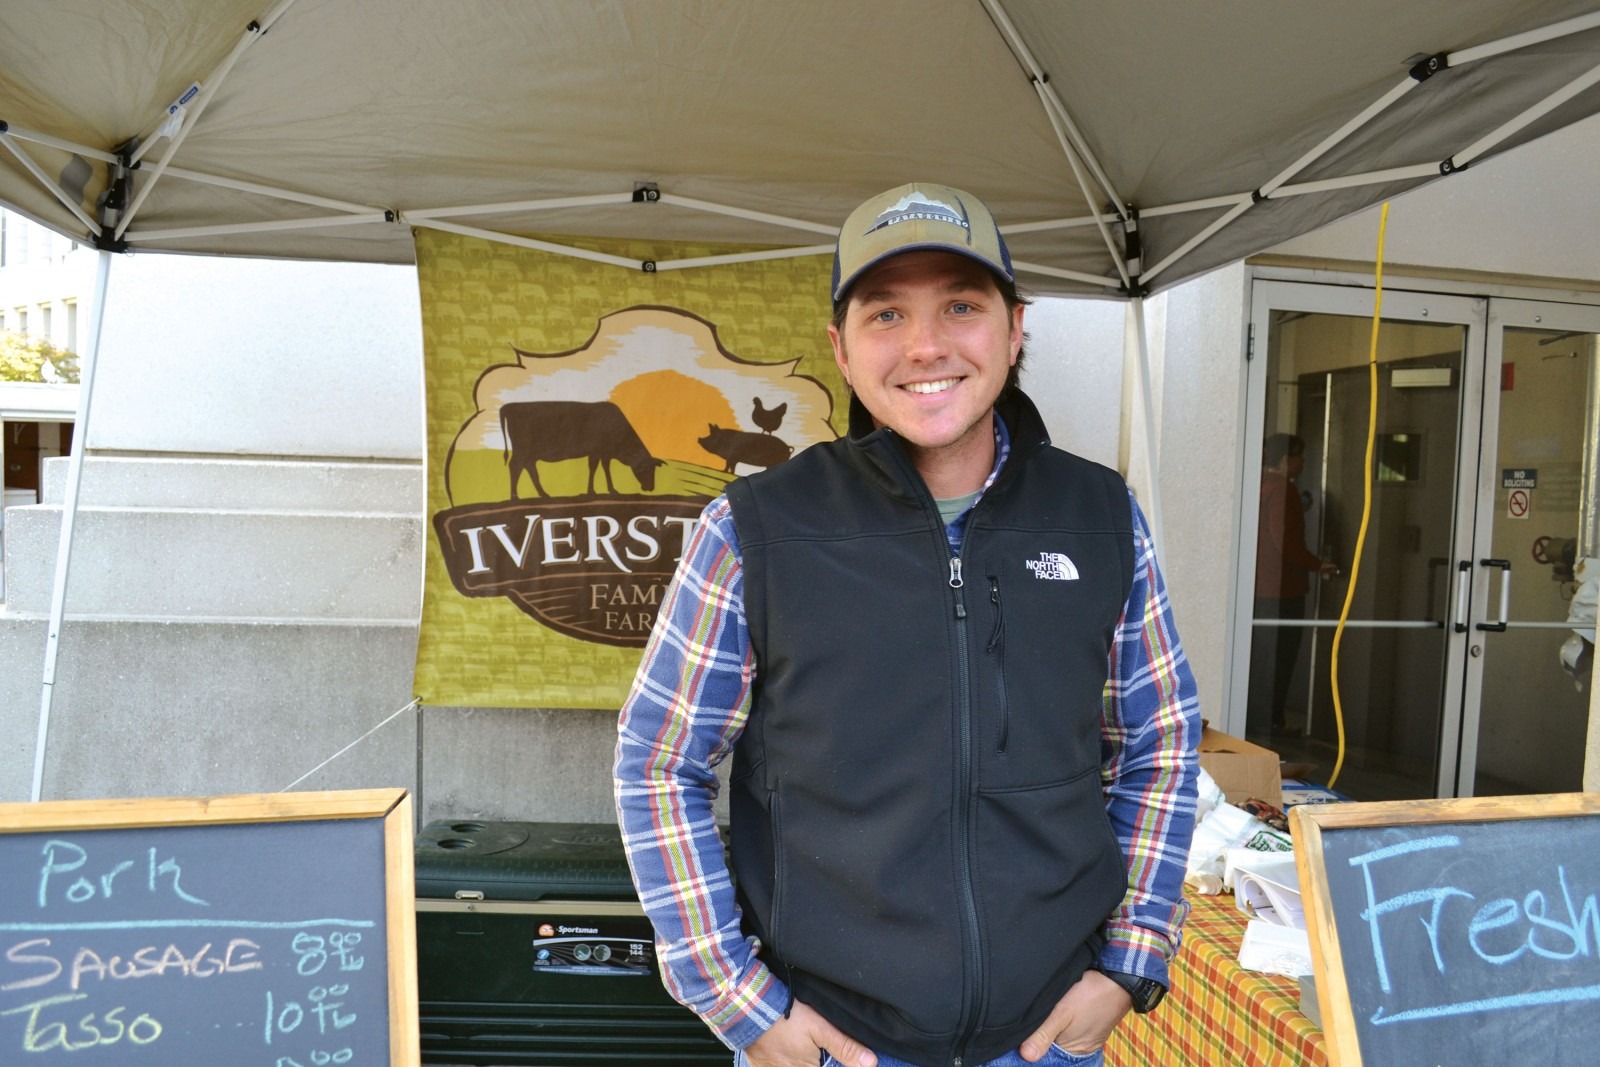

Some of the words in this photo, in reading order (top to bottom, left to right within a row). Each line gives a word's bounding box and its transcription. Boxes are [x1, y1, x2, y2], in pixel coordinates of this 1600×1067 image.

[1514, 471, 1525, 479] NO
[1504, 479, 1535, 487] SOLICITING
[460, 514, 700, 574] IVERST
[1040, 552, 1059, 562] THE
[1025, 560, 1059, 571] NORTH
[1035, 570, 1061, 580] FACE
[38, 840, 210, 907] Pork
[1348, 835, 1600, 994] Fresh
[558, 925, 599, 934] Sportsman
[1, 938, 263, 991] SAUSAGE
[0, 993, 163, 1052] Tasso
